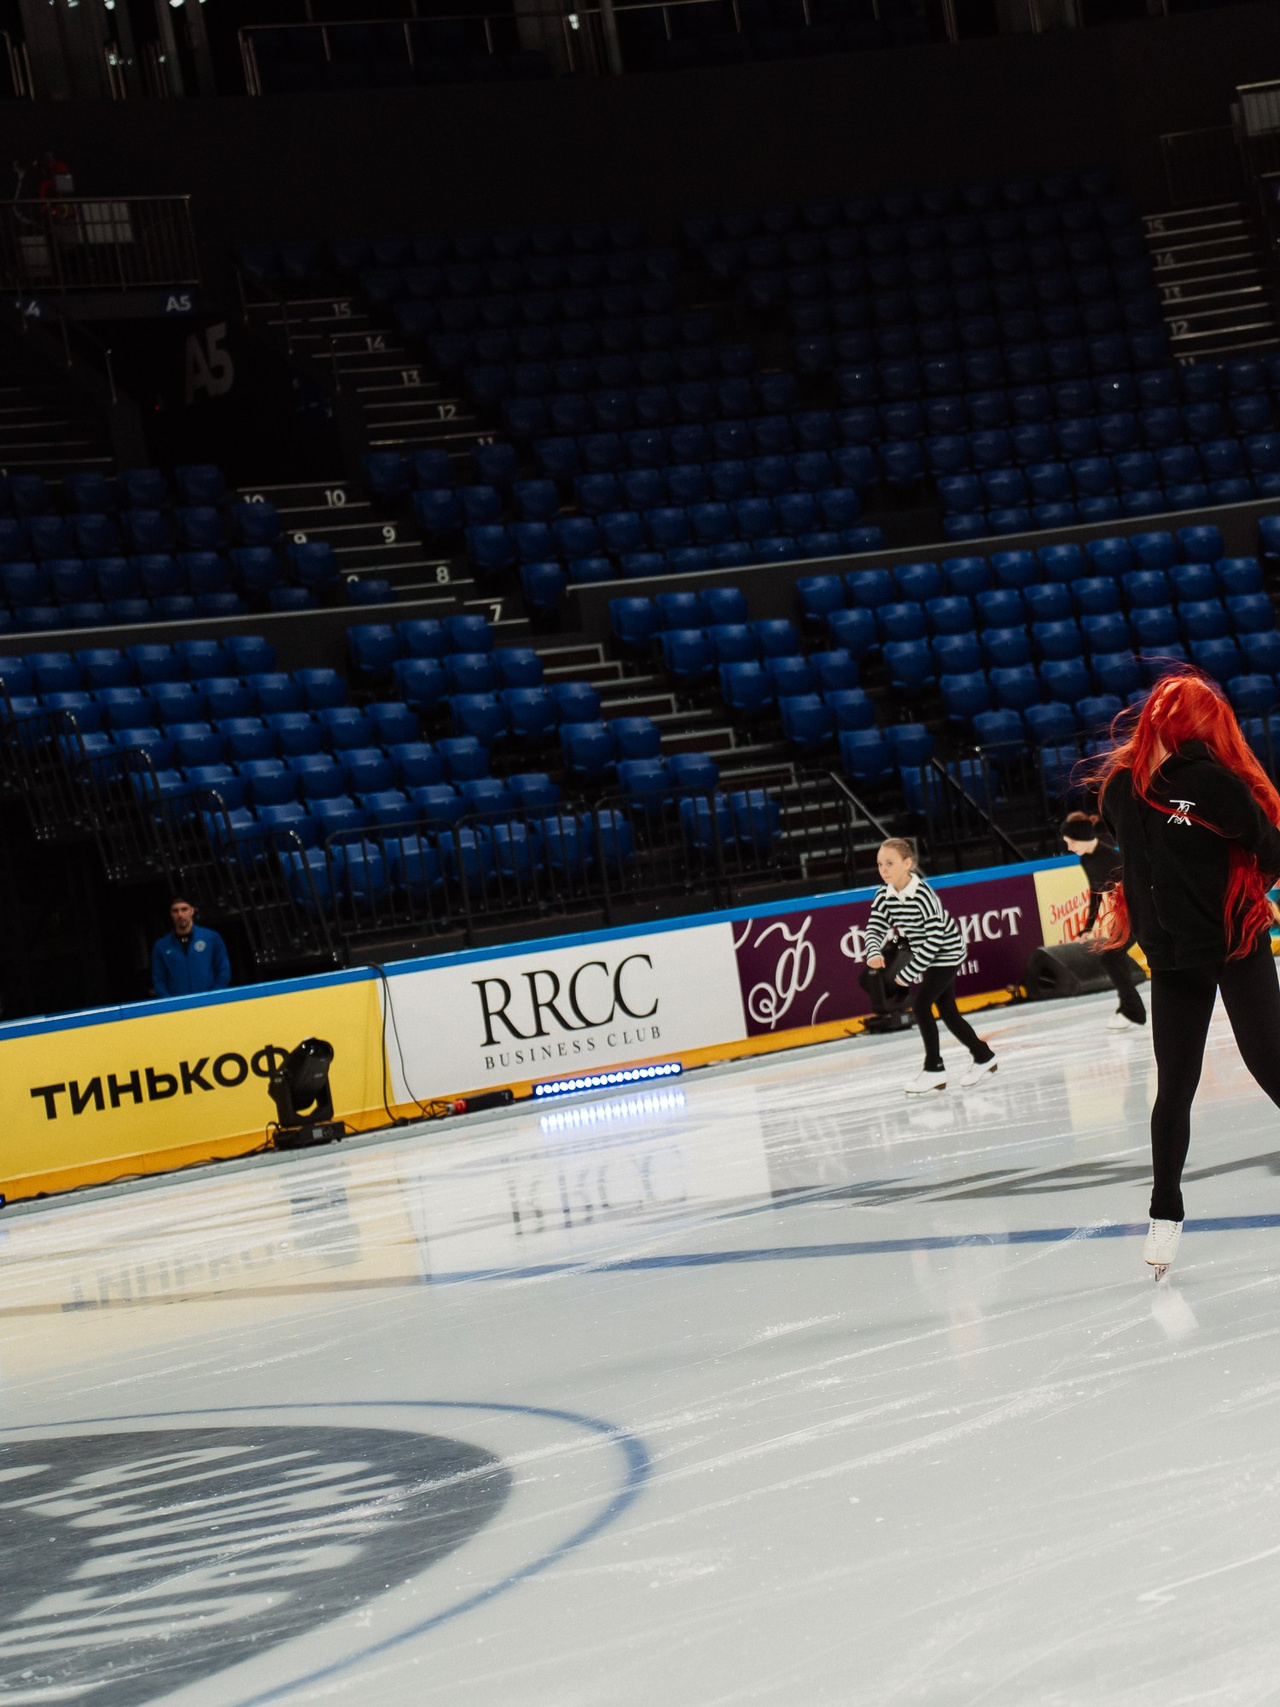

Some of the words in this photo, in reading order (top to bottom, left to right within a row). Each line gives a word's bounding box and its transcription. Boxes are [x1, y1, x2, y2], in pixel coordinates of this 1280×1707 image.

[166, 295, 192, 313] A5
[333, 302, 351, 317] 15
[365, 335, 387, 352] 14
[184, 321, 235, 406] A5
[401, 369, 421, 386] 13
[437, 404, 457, 420] 12
[324, 488, 347, 507] 10
[382, 526, 397, 544] 9
[435, 565, 450, 584] 8
[489, 604, 501, 622] 7
[470, 953, 659, 1048] RRCC
[484, 1037, 597, 1071] BUSINESS
[606, 1025, 662, 1048] CLUB
